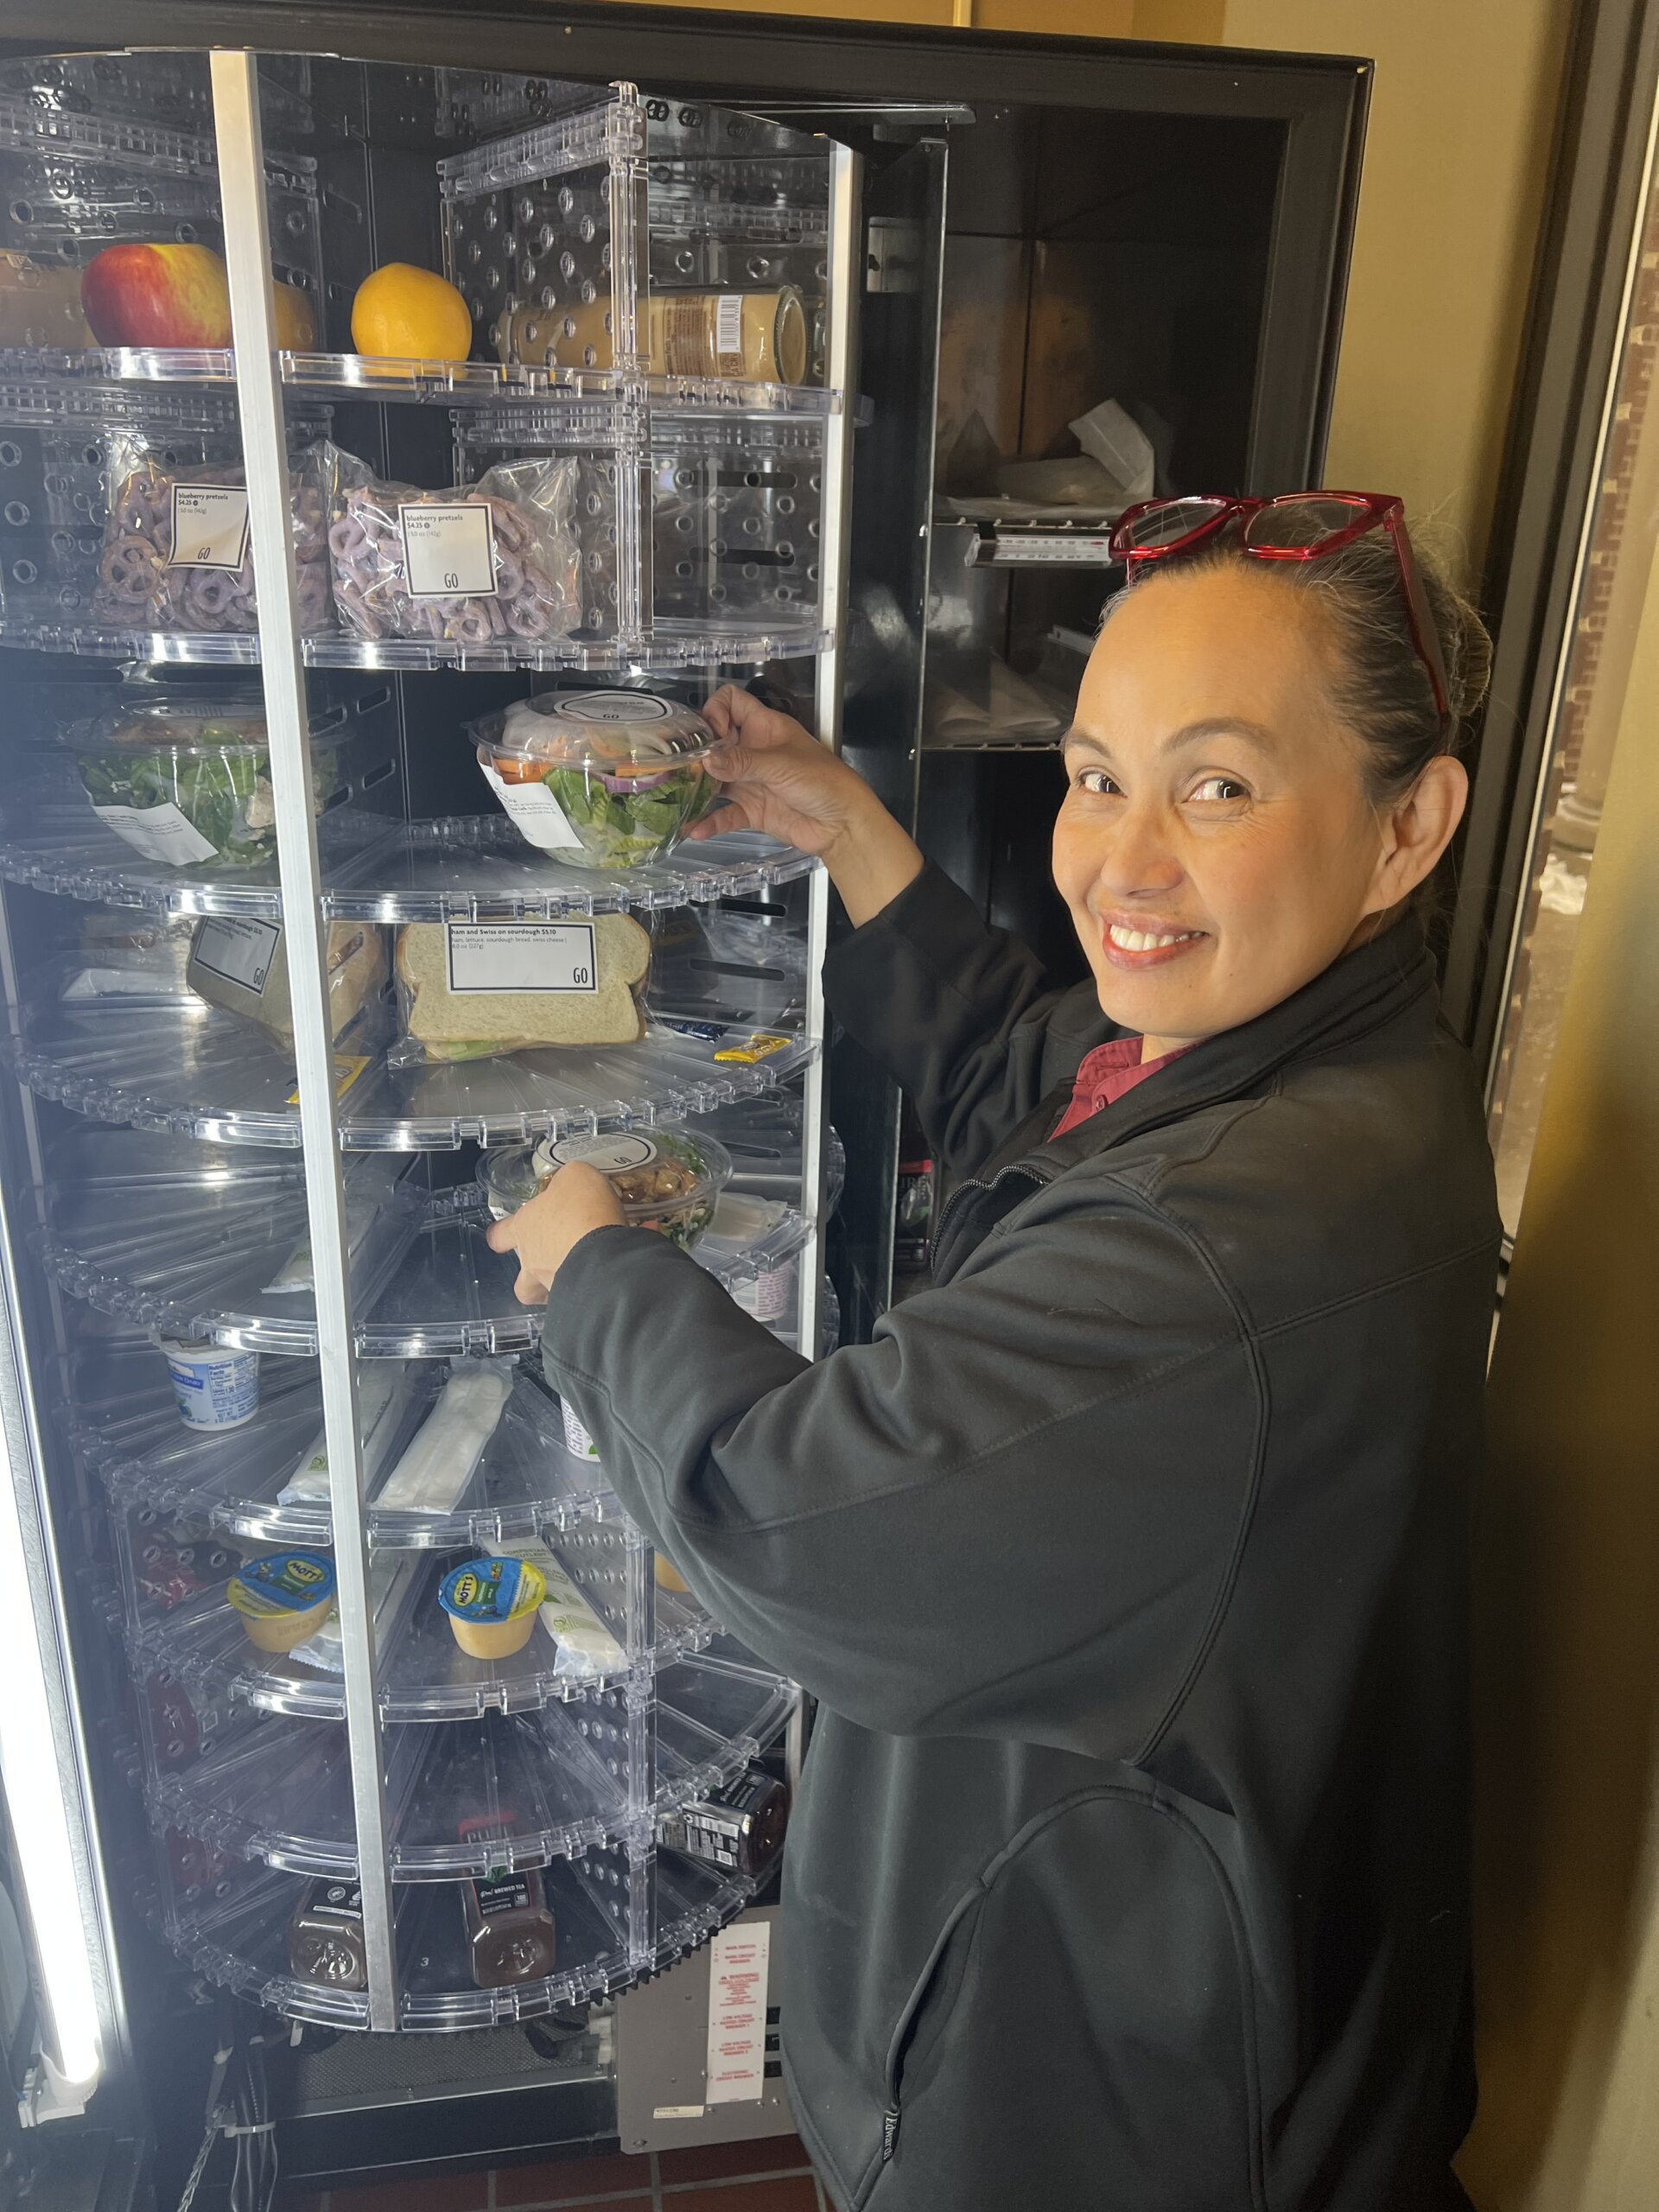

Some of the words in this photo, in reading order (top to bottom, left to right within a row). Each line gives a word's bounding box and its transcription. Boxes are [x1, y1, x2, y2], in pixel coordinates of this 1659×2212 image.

[197, 547, 211, 560] GO
[444, 573, 459, 588] GO
[573, 967, 588, 983] GO
[613, 1156, 633, 1165] GO
[420, 1957, 429, 1967] 3
[883, 2117, 897, 2160] Edwards
